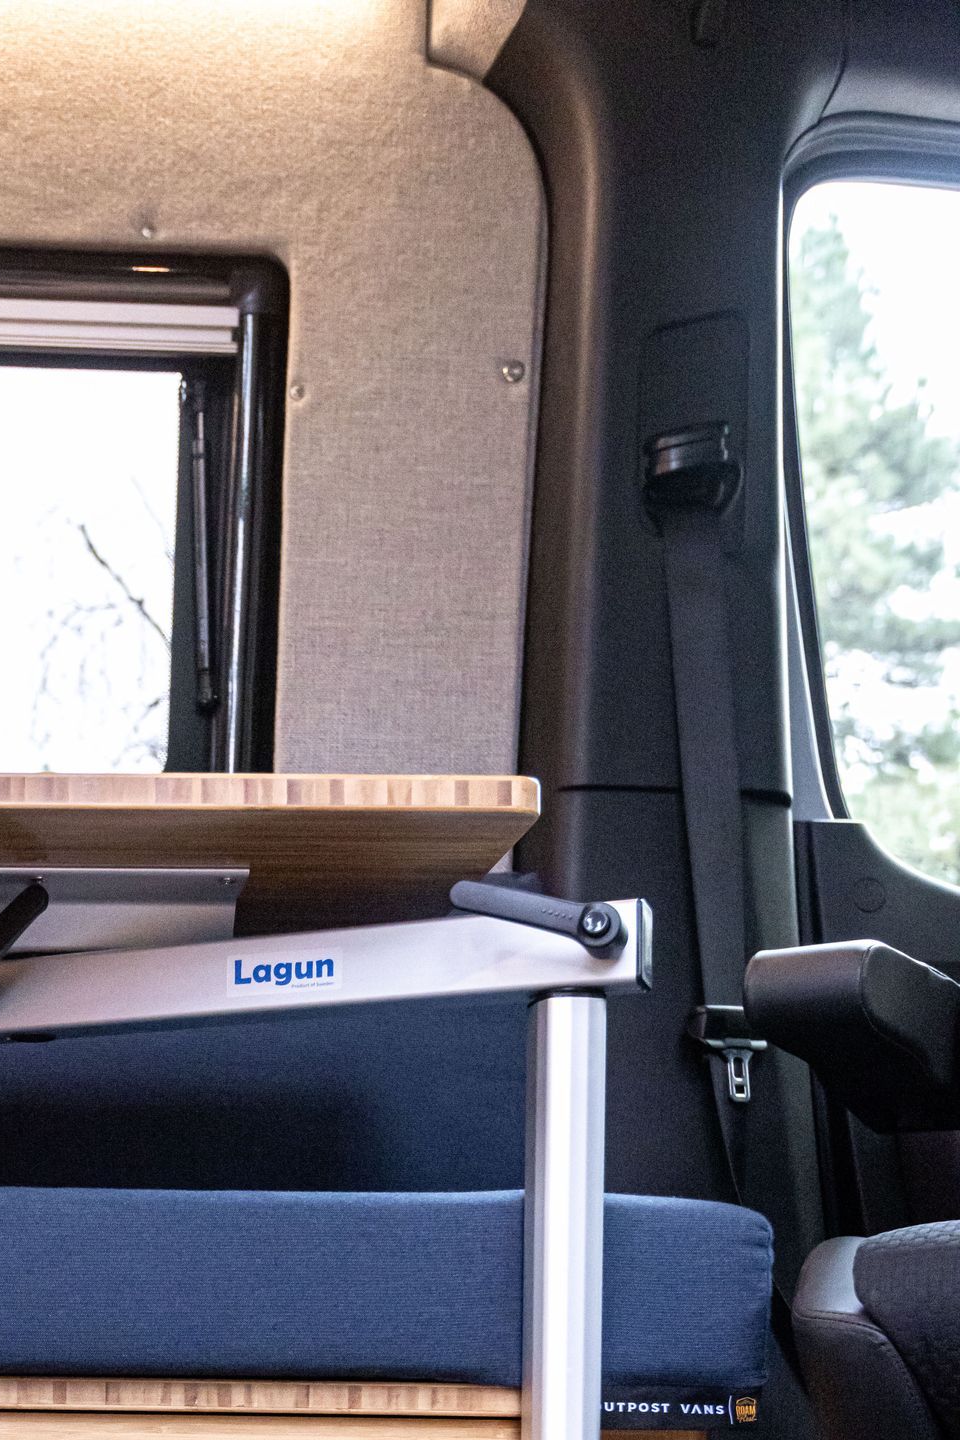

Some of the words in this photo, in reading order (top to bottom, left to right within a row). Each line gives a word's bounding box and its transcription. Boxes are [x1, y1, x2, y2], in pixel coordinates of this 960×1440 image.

[234, 958, 334, 986] Lagun
[601, 1402, 670, 1413] UTPOST
[680, 1403, 725, 1415] VANS
